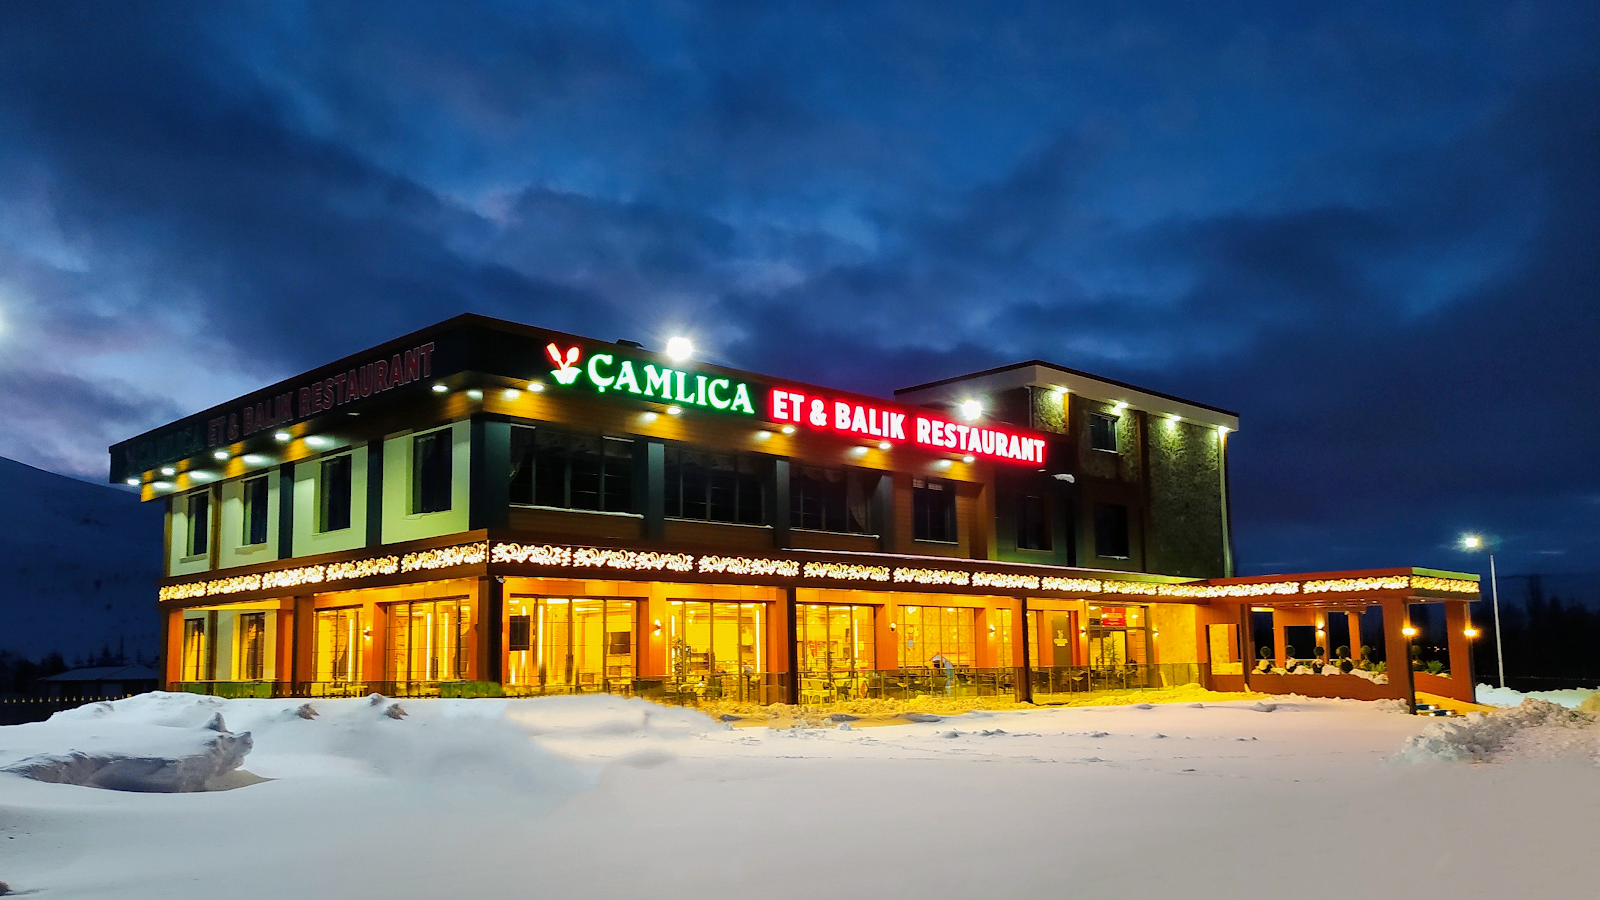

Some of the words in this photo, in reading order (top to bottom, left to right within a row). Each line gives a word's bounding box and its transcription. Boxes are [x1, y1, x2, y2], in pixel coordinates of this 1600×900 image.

[207, 416, 227, 447] ET
[227, 412, 239, 441] &
[243, 391, 293, 436] BALIK
[298, 341, 435, 418] RESTAURANT
[587, 353, 755, 414] ÇAMLICA
[773, 390, 804, 422] ET
[809, 399, 827, 426] &
[835, 402, 905, 440] BALIK
[916, 417, 1046, 463] RESTAURANT
